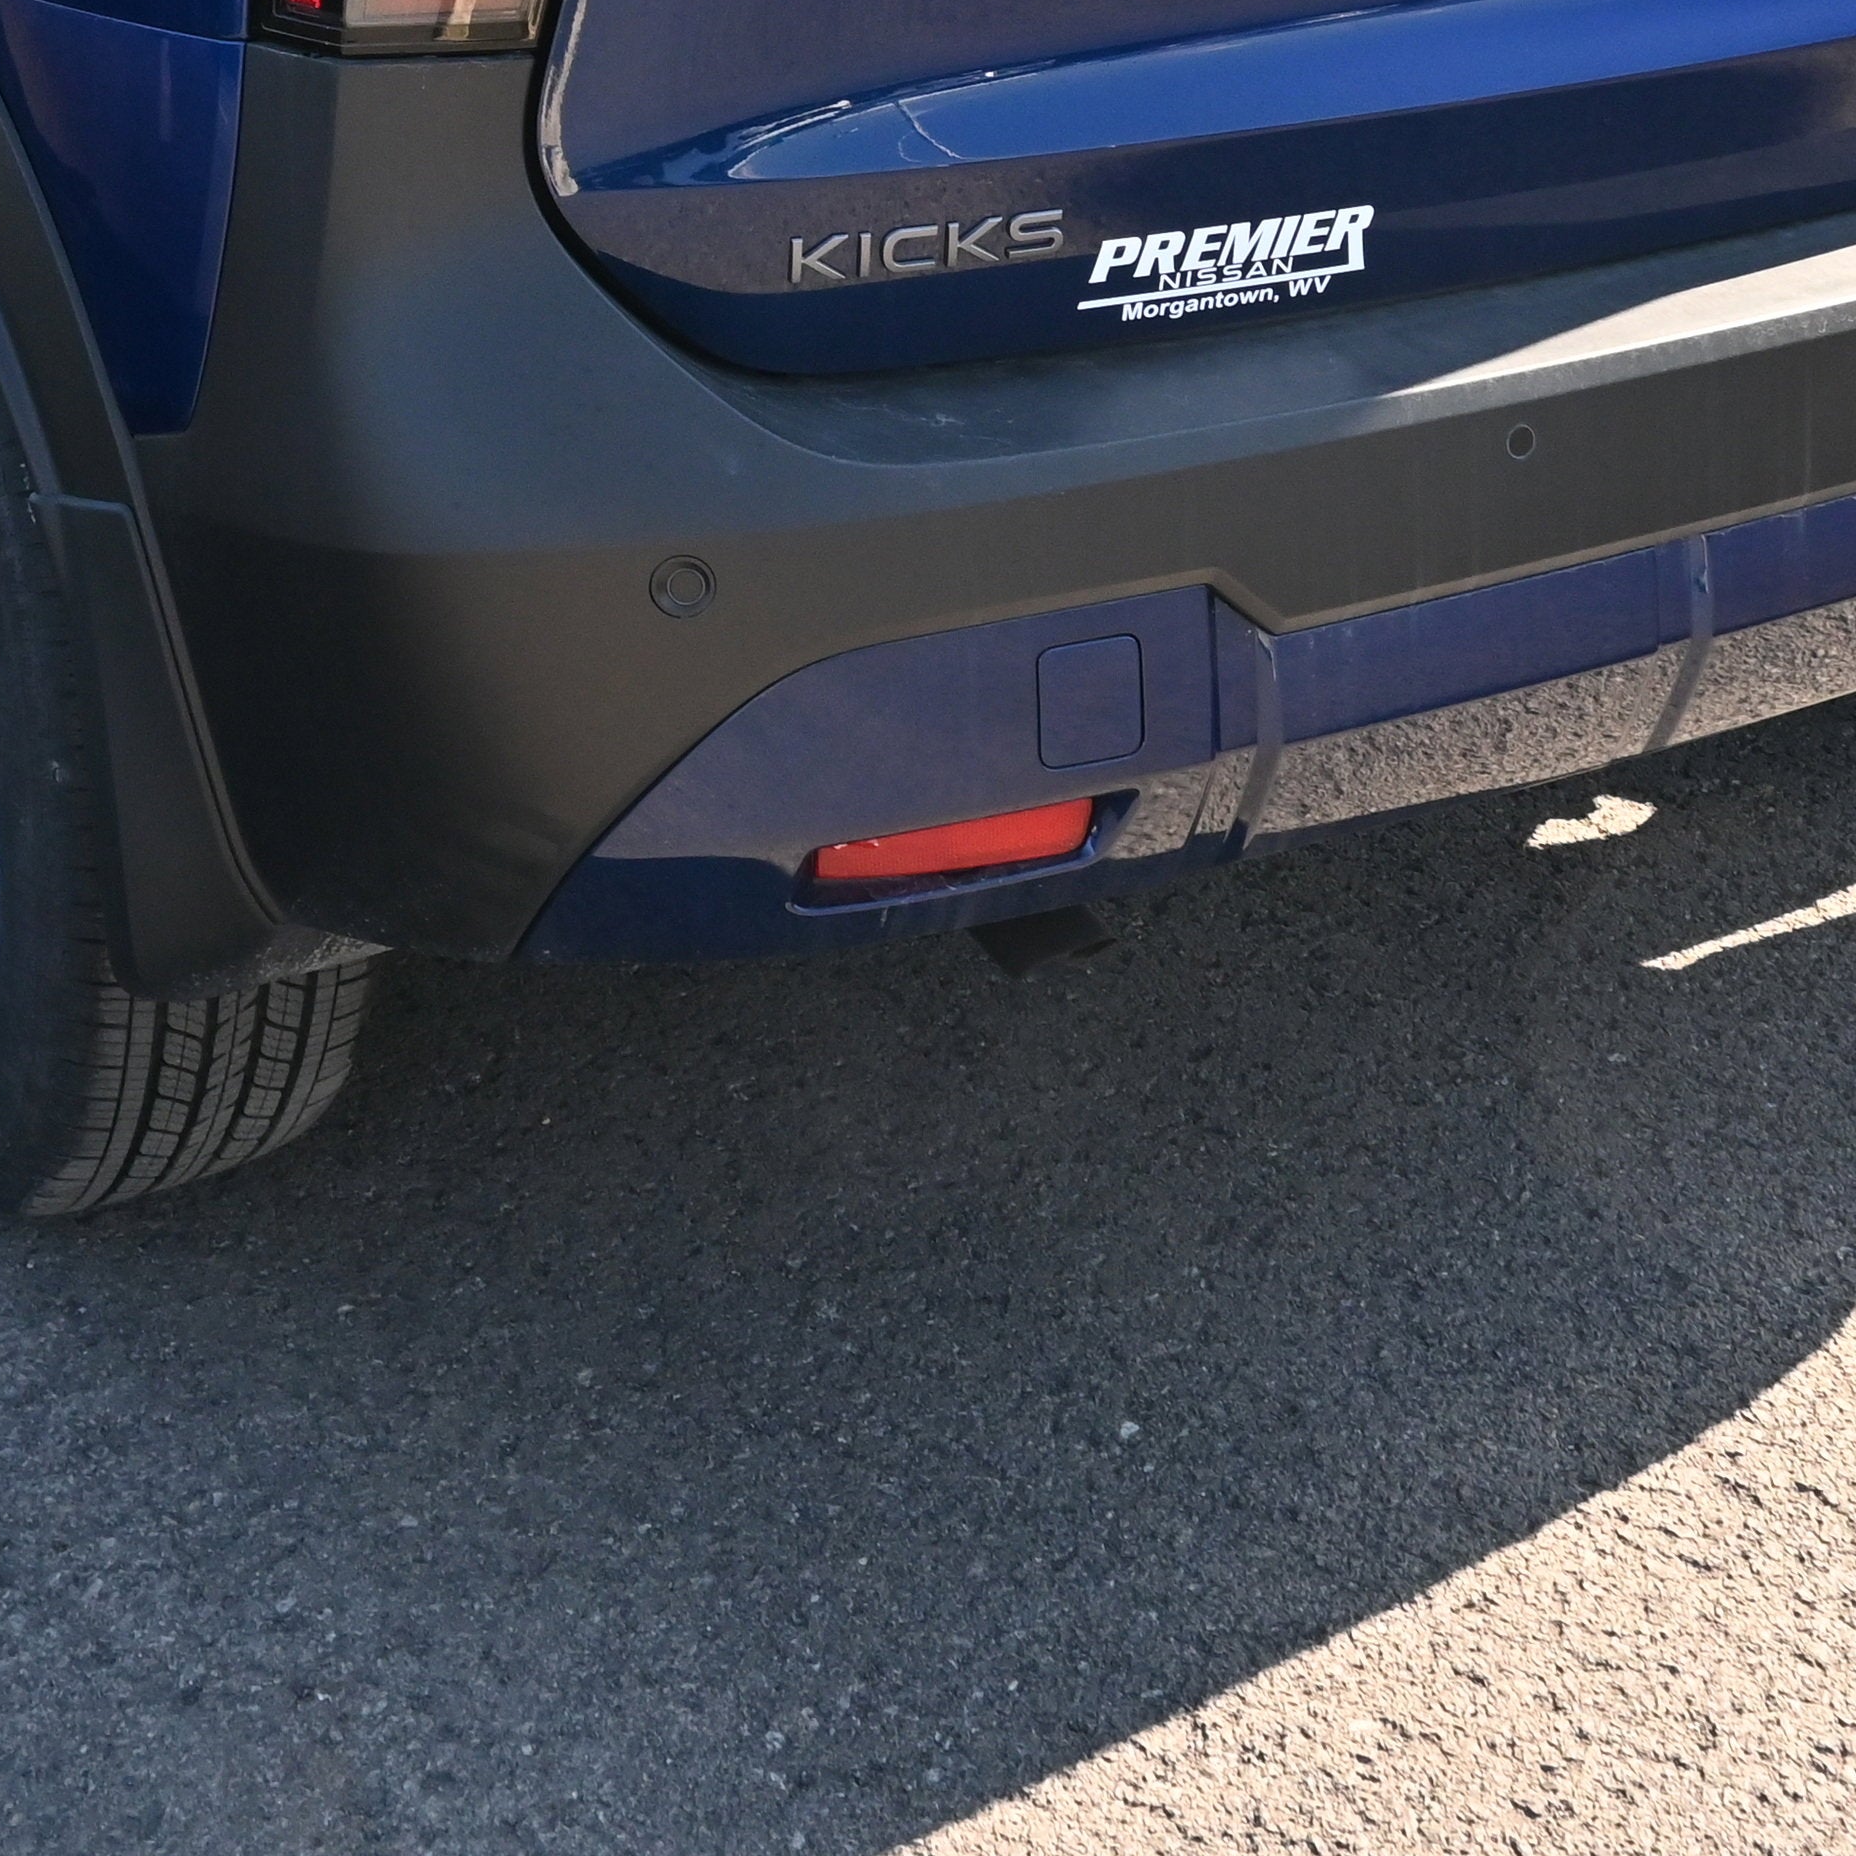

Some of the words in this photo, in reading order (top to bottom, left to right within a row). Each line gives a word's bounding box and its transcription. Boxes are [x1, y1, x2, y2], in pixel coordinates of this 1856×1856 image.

[788, 208, 1064, 284] KICKS
[1088, 204, 1375, 284] PREMIER
[1158, 256, 1294, 292] NISSAN
[1121, 286, 1280, 322] Morgantown,
[1288, 274, 1332, 298] WV
